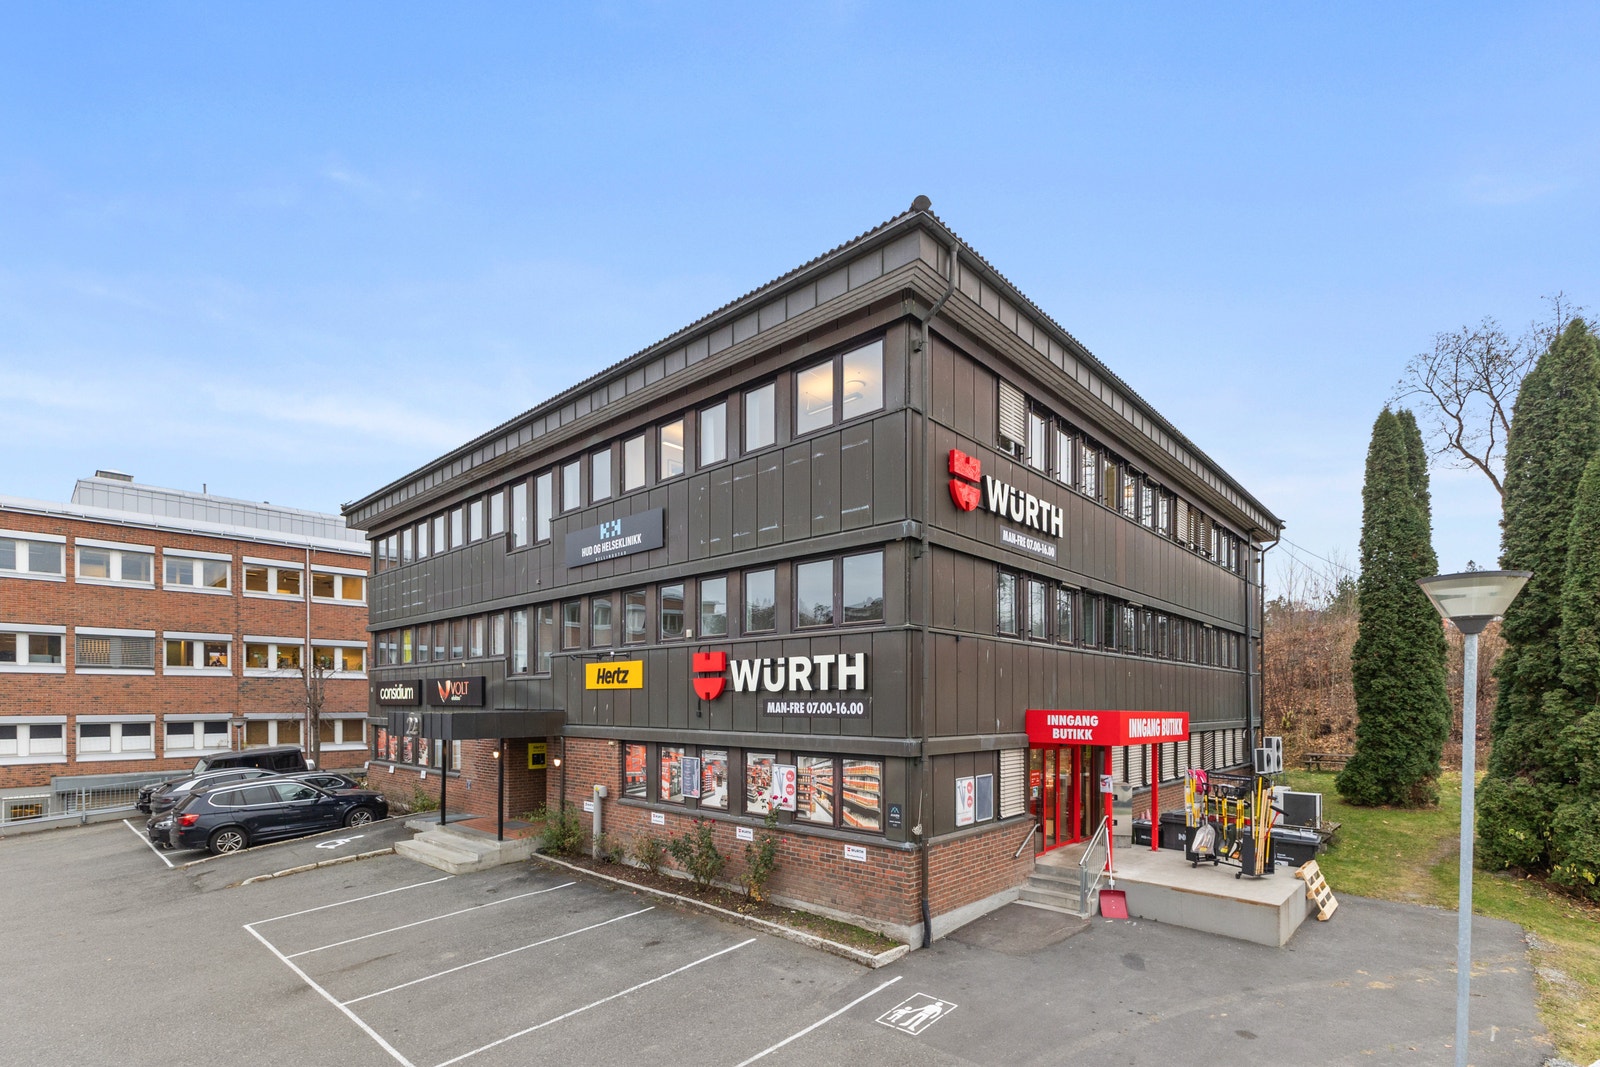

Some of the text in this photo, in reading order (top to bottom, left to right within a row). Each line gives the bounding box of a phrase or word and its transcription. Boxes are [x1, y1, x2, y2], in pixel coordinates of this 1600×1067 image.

[984, 475, 1064, 538] WÜRTH
[581, 533, 642, 558] HUD OG HELSEKLINIKK
[1002, 529, 1056, 558] MAN-FRE 07.00-16.00
[596, 667, 629, 685] Hertz
[730, 652, 866, 693] WÜRTH
[380, 683, 414, 700] considium
[450, 681, 469, 696] VOLT
[767, 701, 864, 715] MAN-FRE 07.00-16.00
[1047, 714, 1099, 727] INNGANG
[1128, 718, 1184, 738] INNGANG BUTIKK
[1052, 728, 1093, 741] BUTIKK
